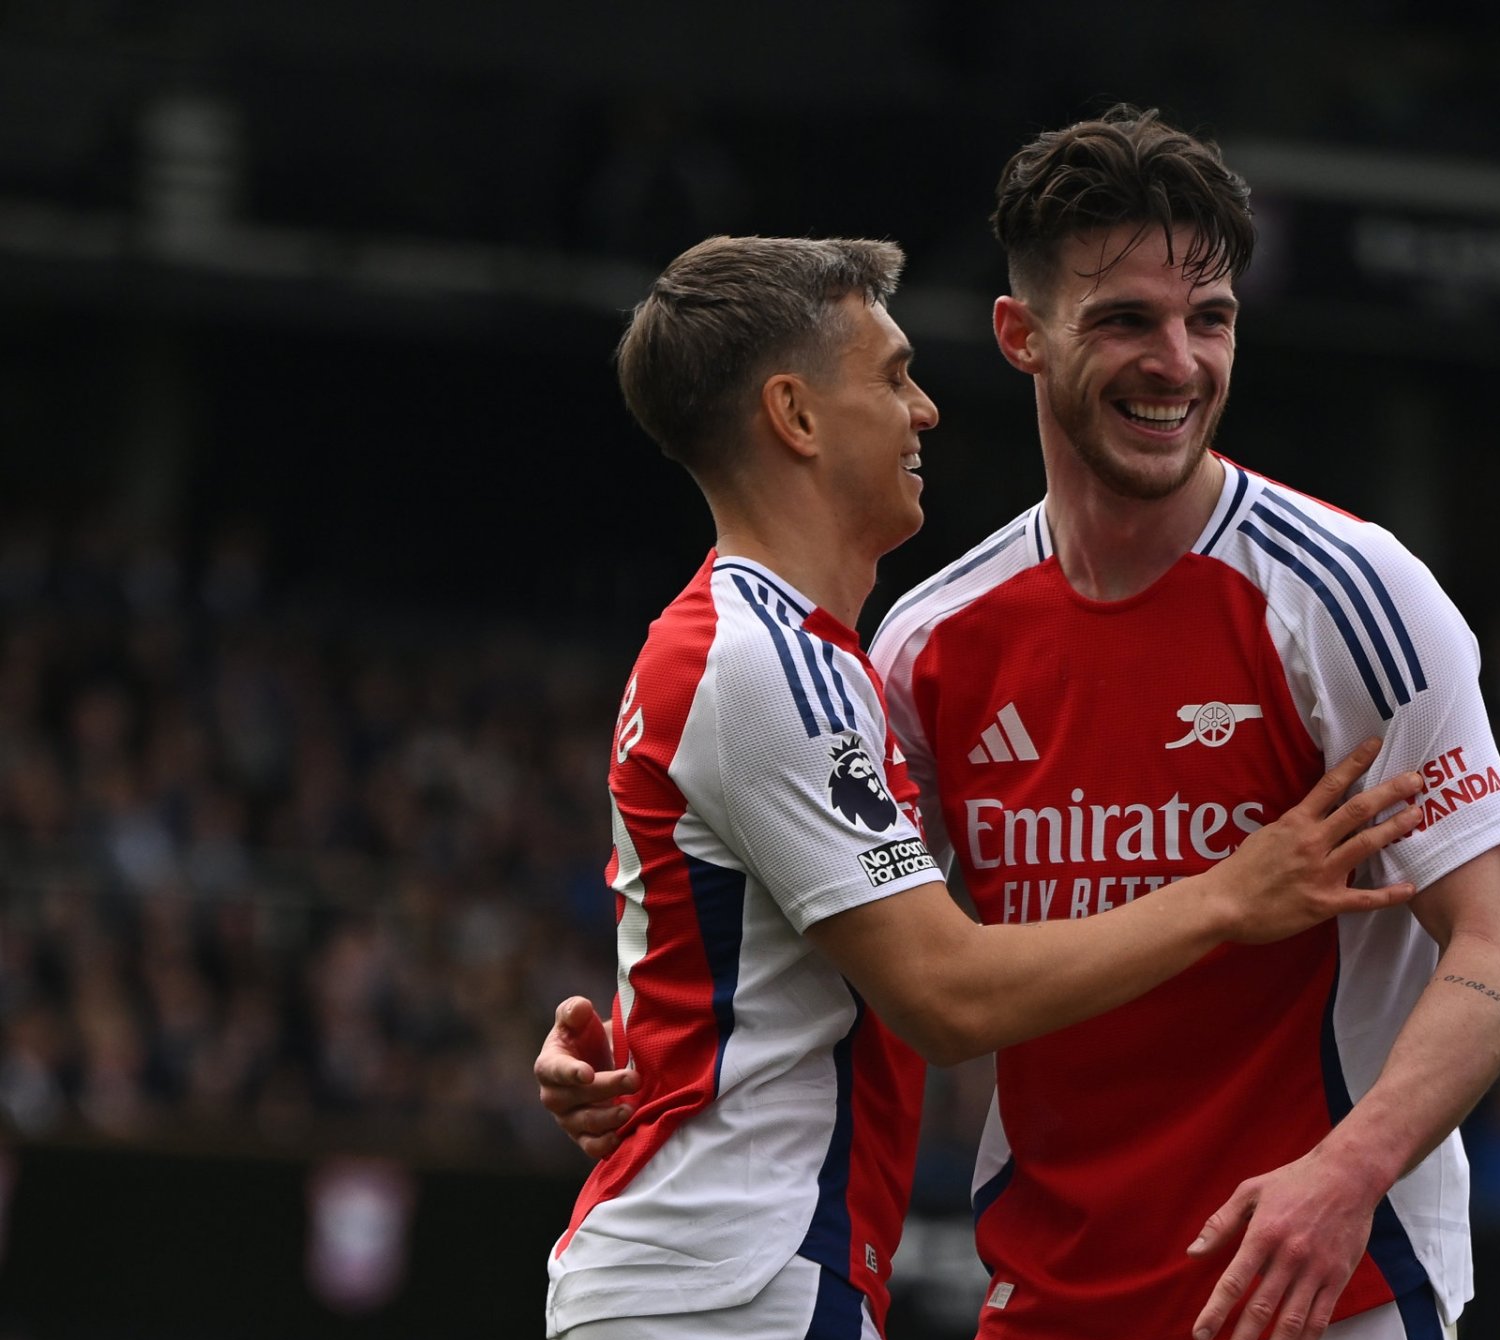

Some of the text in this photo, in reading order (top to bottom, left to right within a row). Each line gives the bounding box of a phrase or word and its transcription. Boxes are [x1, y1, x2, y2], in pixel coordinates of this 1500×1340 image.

[965, 788, 1264, 870] Emirates
[859, 841, 929, 872] No room
[867, 863, 898, 886] for
